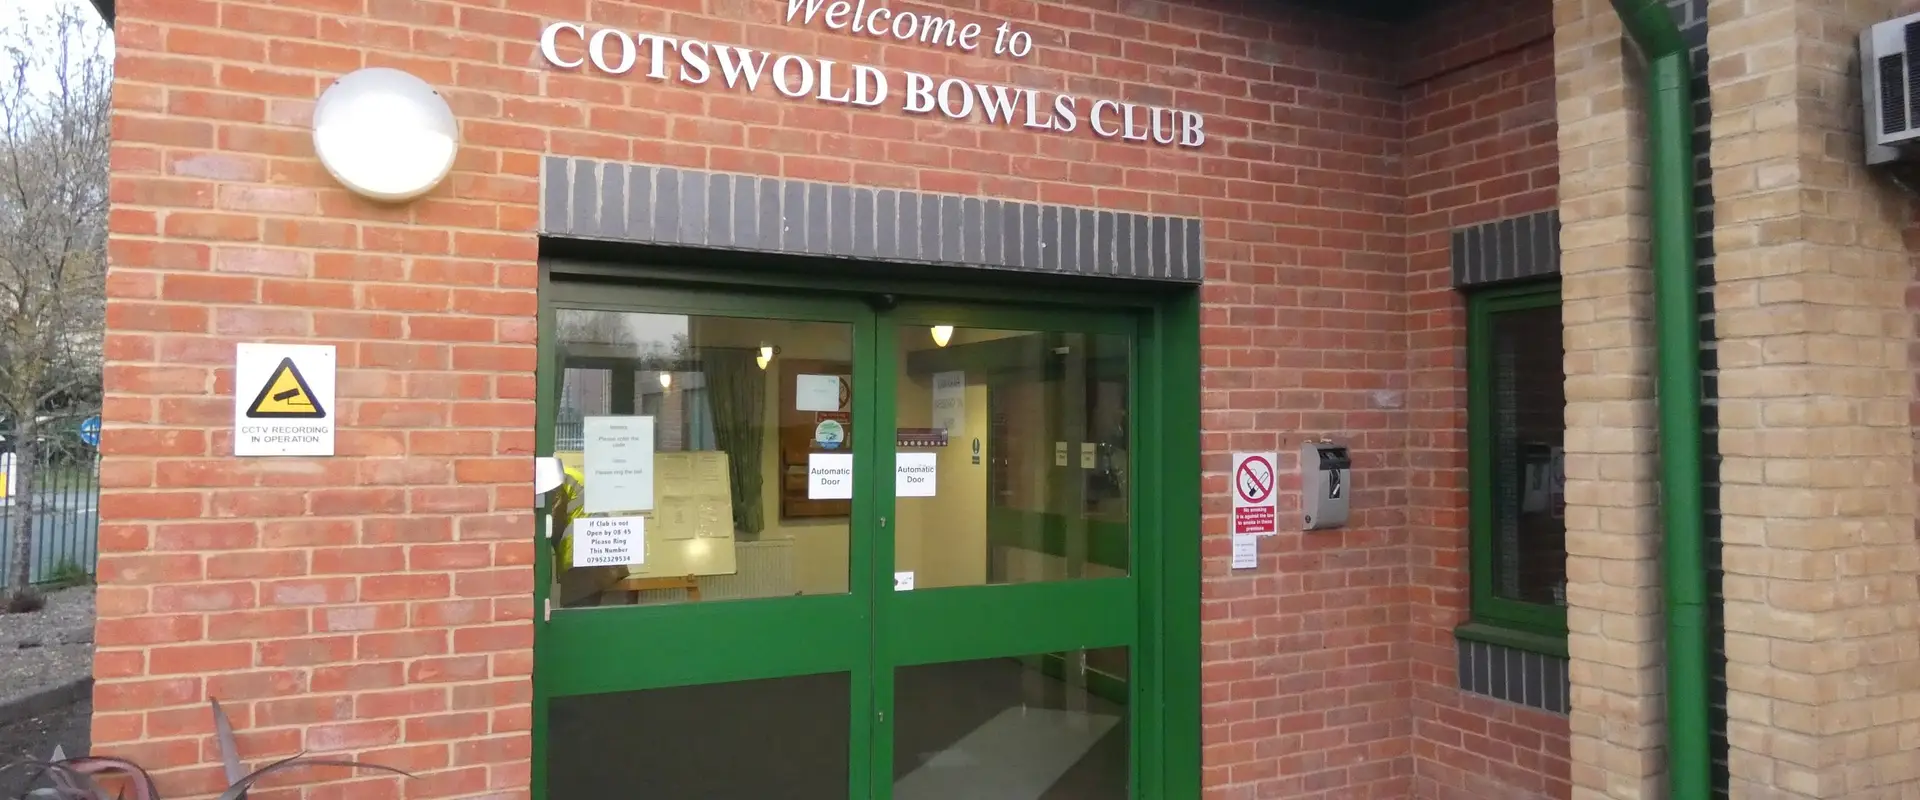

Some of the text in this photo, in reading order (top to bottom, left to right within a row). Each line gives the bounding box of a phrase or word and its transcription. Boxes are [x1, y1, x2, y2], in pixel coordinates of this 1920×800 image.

[785, 0, 1033, 57] Welcome to
[540, 21, 1205, 147] COTSWOLD BOWLS CLUB
[241, 426, 329, 434] CCTV RECORDING
[251, 435, 320, 443] IN OPERATION
[811, 467, 851, 475] Automatic
[897, 465, 934, 474] Automatic
[821, 477, 841, 486] Door
[906, 475, 925, 484] Door
[604, 529, 612, 537] by
